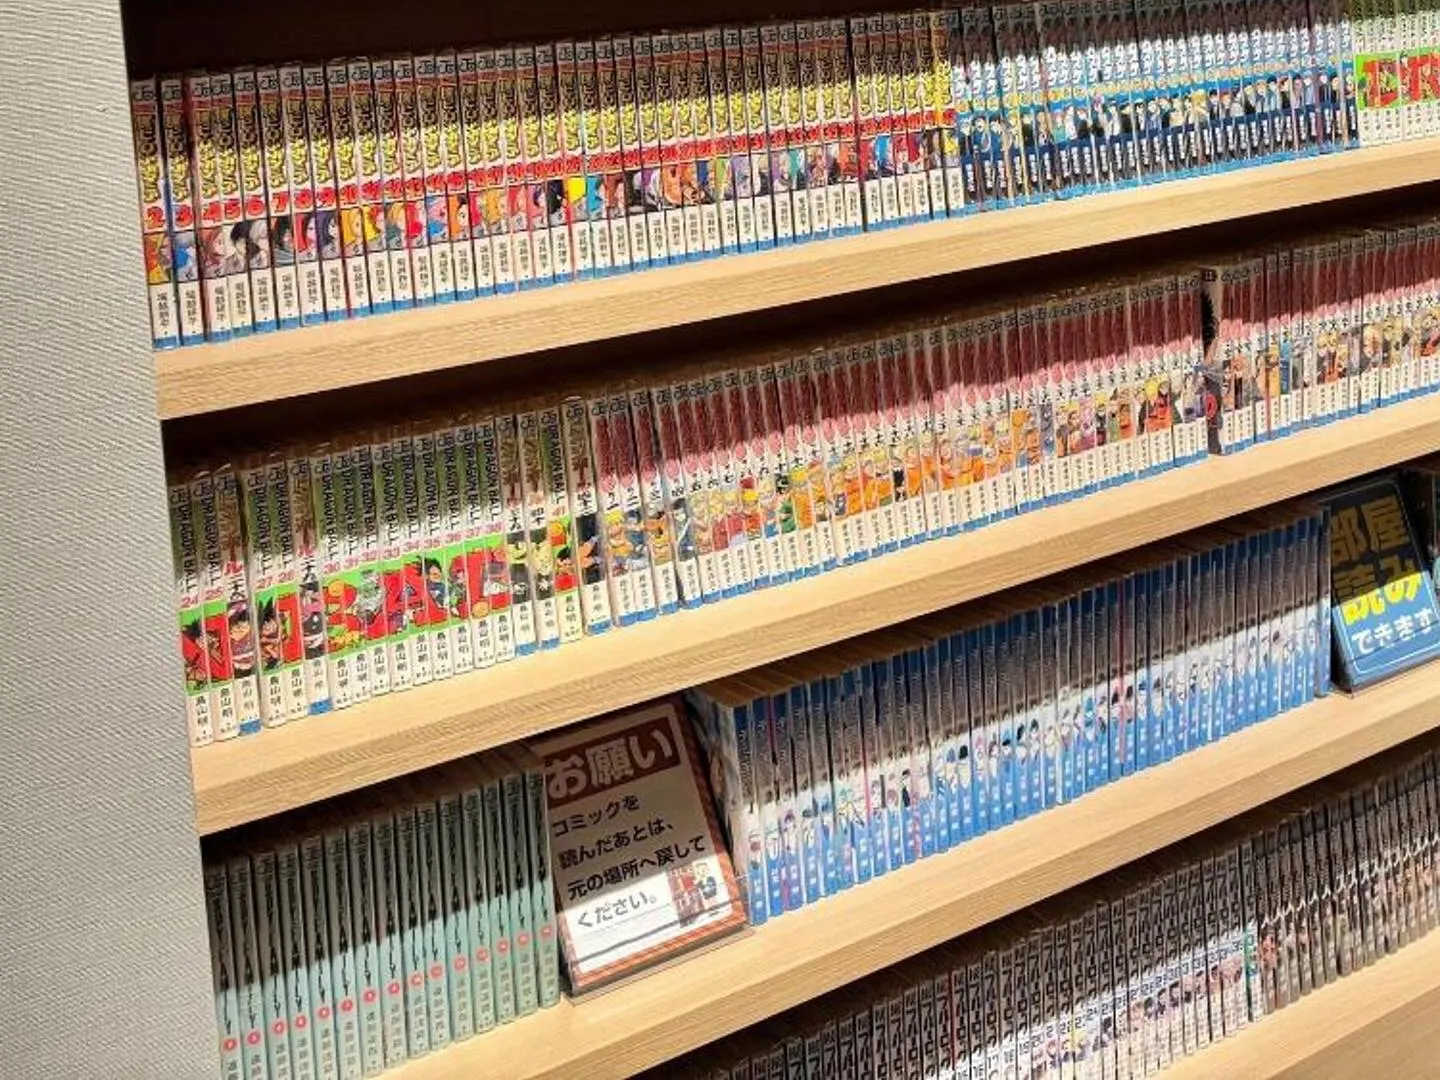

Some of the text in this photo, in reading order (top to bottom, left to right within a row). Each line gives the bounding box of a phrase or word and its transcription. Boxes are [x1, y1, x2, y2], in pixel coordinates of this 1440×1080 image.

[1331, 495, 1411, 566] 部屋
[1333, 556, 1422, 625] 読み
[1352, 608, 1432, 654] できます
[548, 728, 674, 799] お願い
[552, 795, 640, 837] コミックを
[558, 818, 674, 870] 読んだあとは、
[568, 836, 706, 900] 元の場所へ戻して
[578, 891, 658, 928] ください。
